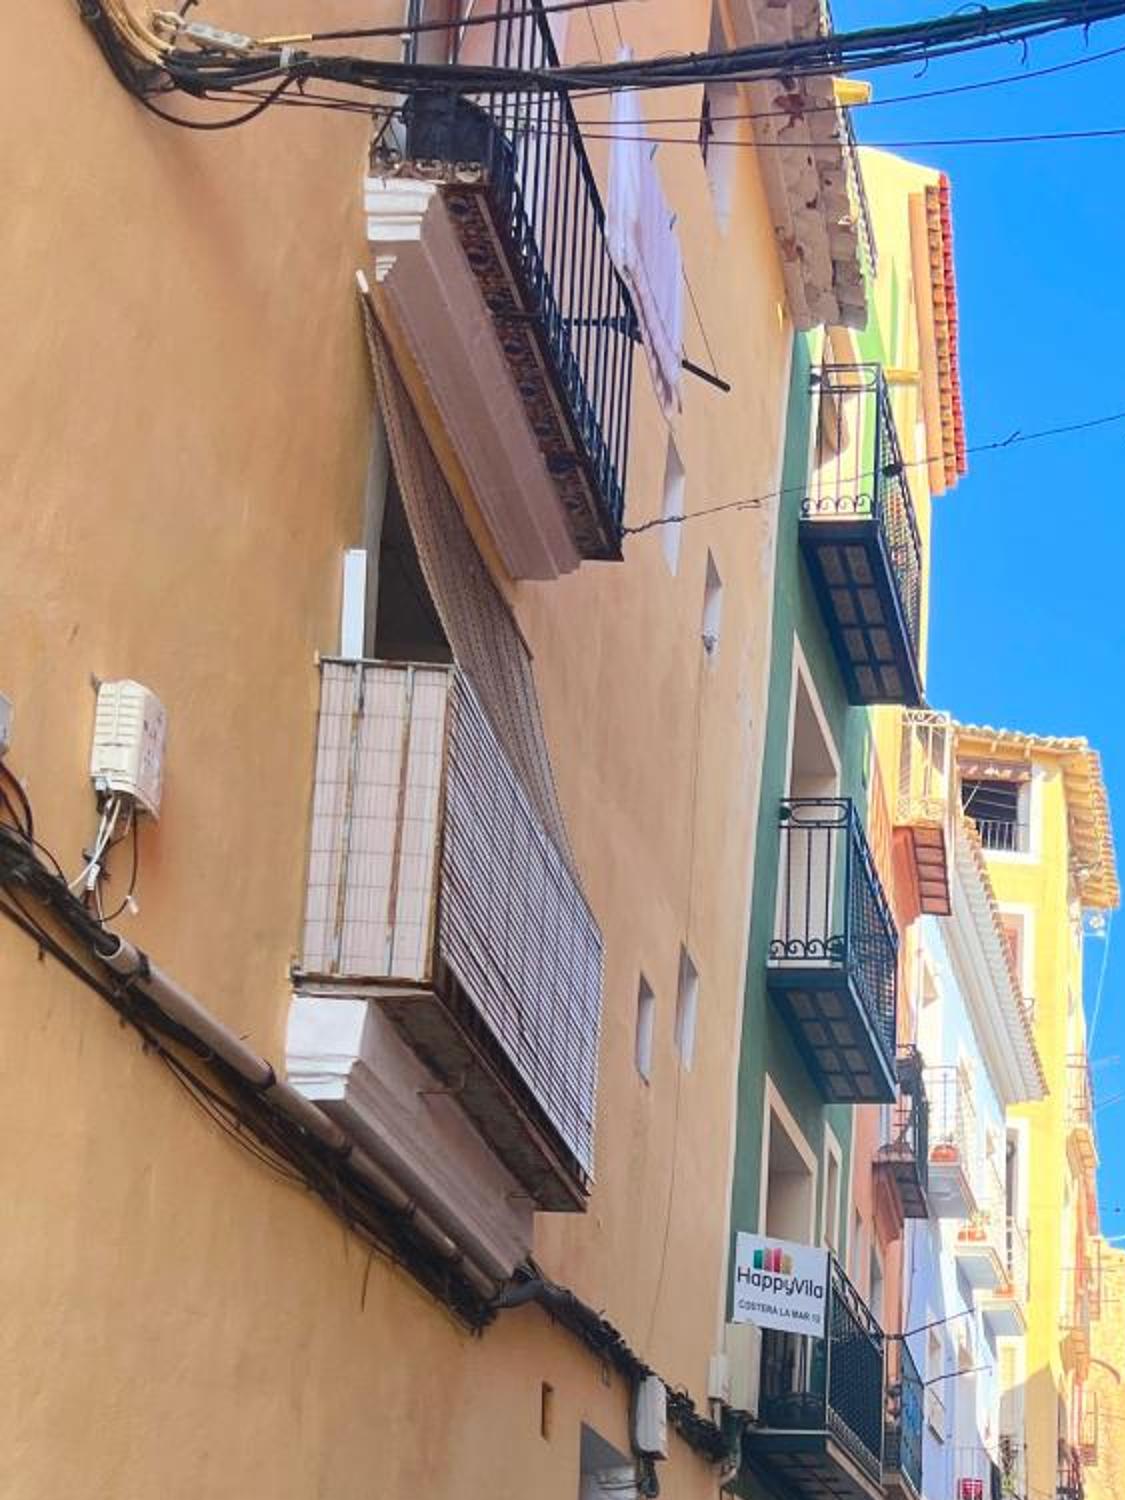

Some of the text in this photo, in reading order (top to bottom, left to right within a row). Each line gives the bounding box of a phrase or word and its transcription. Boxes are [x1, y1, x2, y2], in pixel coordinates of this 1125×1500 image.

[737, 1266, 823, 1299] HappyVila
[738, 1299, 778, 1315] COSTERA
[780, 1307, 790, 1318] LA
